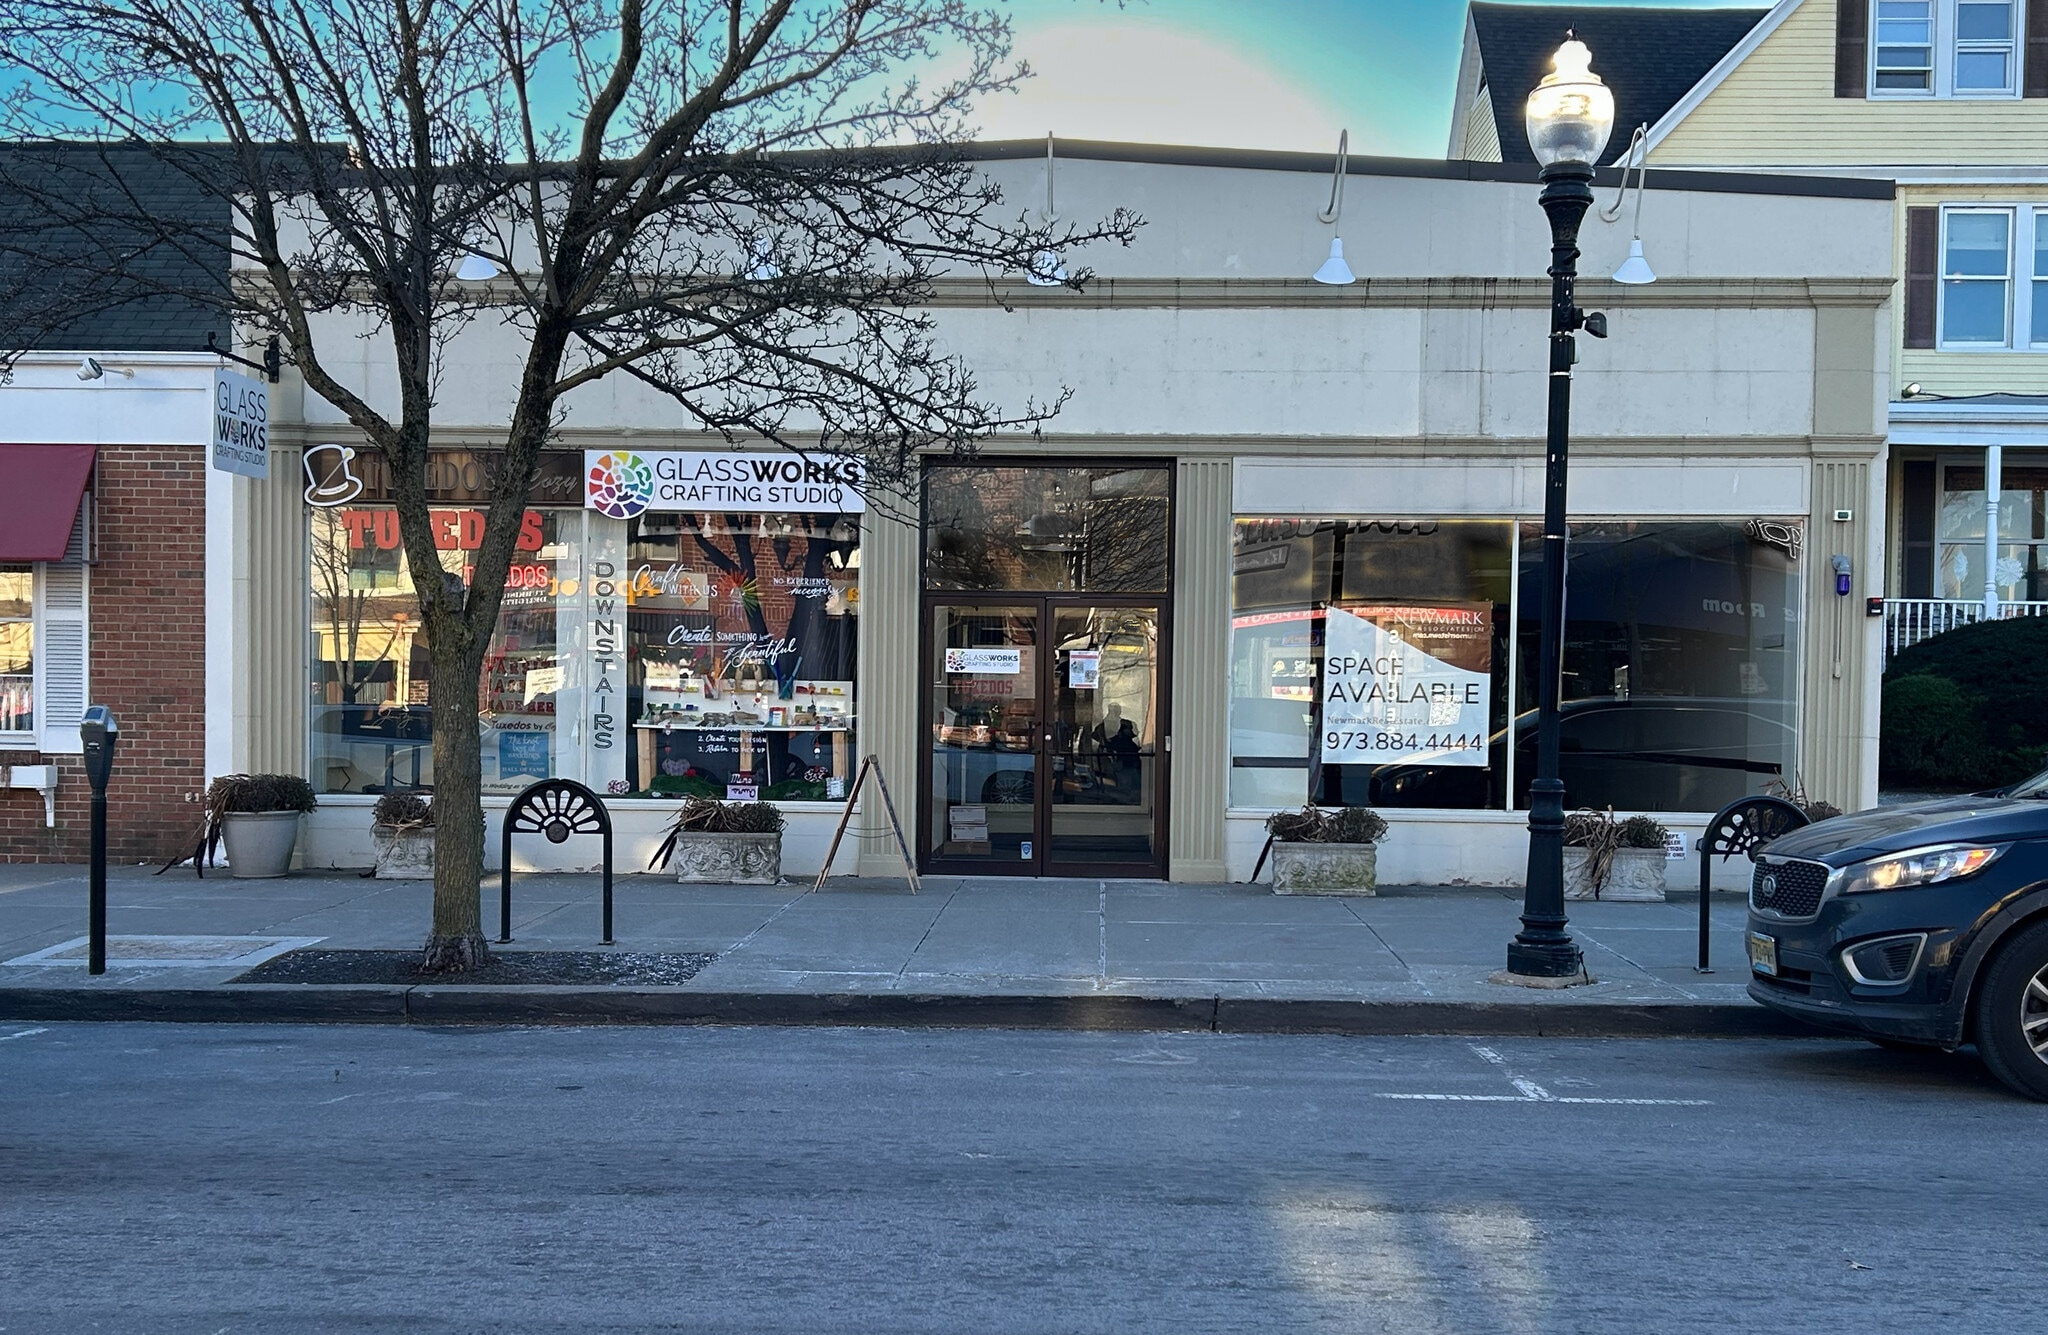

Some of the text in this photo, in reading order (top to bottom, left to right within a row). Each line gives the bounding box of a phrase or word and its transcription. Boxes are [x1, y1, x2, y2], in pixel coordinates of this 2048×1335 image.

[217, 381, 266, 423] GLASS
[215, 444, 266, 467] CRAFTING STUDIO
[656, 457, 859, 485] GLASSWORKS
[659, 485, 843, 504] CRAFTING STUDIO
[341, 510, 544, 551] TUEDS
[632, 563, 693, 594] Craft
[773, 577, 830, 586] NO EXPERIENCE
[668, 584, 718, 598] WITH US
[1392, 610, 1485, 628] NEWMARK
[667, 624, 758, 645] Create SOMETHING
[594, 561, 616, 750] DOWNSTAIRS
[731, 637, 797, 667] beautiful
[963, 654, 1019, 662] GLASSWORKS
[1328, 657, 1404, 675] SPACE
[952, 679, 1013, 695] TUXEDOS
[491, 720, 532, 730] Tuxedos
[533, 722, 543, 732] by
[1326, 732, 1484, 752] 973.884.4444
